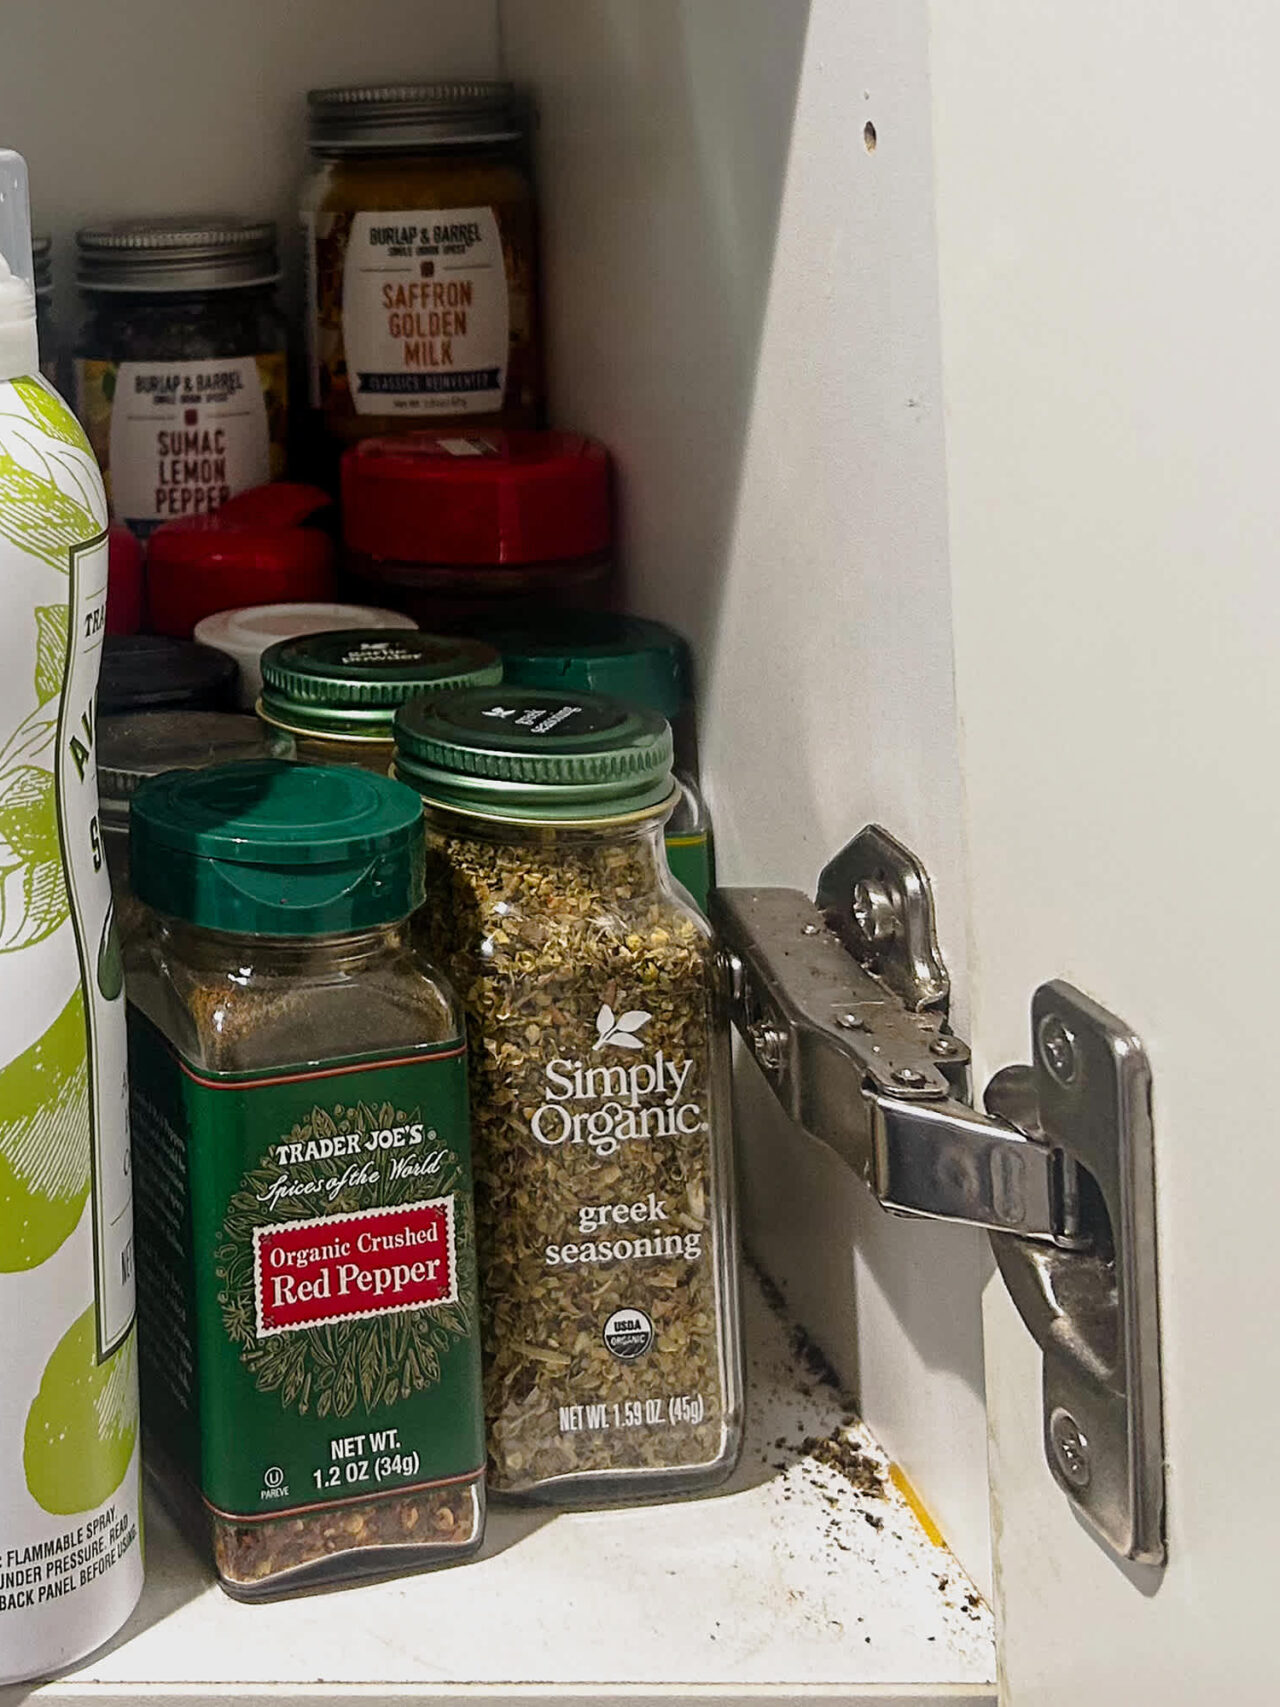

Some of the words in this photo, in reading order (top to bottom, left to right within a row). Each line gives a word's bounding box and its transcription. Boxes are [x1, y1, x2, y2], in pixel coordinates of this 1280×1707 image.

[370, 227, 418, 245] BURLAP
[421, 228, 429, 243] &
[433, 223, 482, 247] BARREL
[382, 280, 473, 309] SAFFRON
[389, 311, 467, 338] GOLDEN
[404, 340, 453, 366] MILK
[184, 377, 193, 392] &
[196, 371, 244, 395] BARREL
[157, 430, 226, 456] SUMAC
[159, 458, 226, 485] LEMON
[85, 605, 105, 637] TRA
[546, 1050, 693, 1107] Simply
[276, 1131, 362, 1165] TRADER
[365, 1124, 424, 1150] JOE'S
[257, 1173, 322, 1211] Spices
[325, 1163, 356, 1202] of
[350, 1161, 380, 1187] the
[390, 1149, 448, 1180] World
[578, 1192, 669, 1233] greek
[270, 1237, 351, 1268] Organic
[357, 1222, 438, 1253] Crushed
[545, 1229, 702, 1265] seasoning
[271, 1268, 331, 1308] Red
[336, 1259, 441, 1296] Pepper
[610, 1334, 646, 1346] ORGANIC
[614, 1319, 642, 1332] USDA
[559, 1404, 584, 1431] NET
[613, 1401, 642, 1428] 1.59
[669, 1393, 704, 1425] (45g)
[331, 1435, 365, 1460] NET
[369, 1429, 401, 1452] WT.
[313, 1466, 341, 1489] 1.2
[346, 1461, 369, 1482] OZ
[375, 1451, 420, 1482] (34g)
[261, 1486, 289, 1499] PAREVE
[7, 1529, 83, 1568] FLAMMABLE
[86, 1505, 118, 1539] SPRAY.
[46, 1537, 107, 1577] PRESSURE.
[109, 1513, 128, 1545] READ
[0, 1590, 35, 1612] BACK
[38, 1576, 77, 1603] PANEL
[79, 1549, 116, 1587] BEFORE
